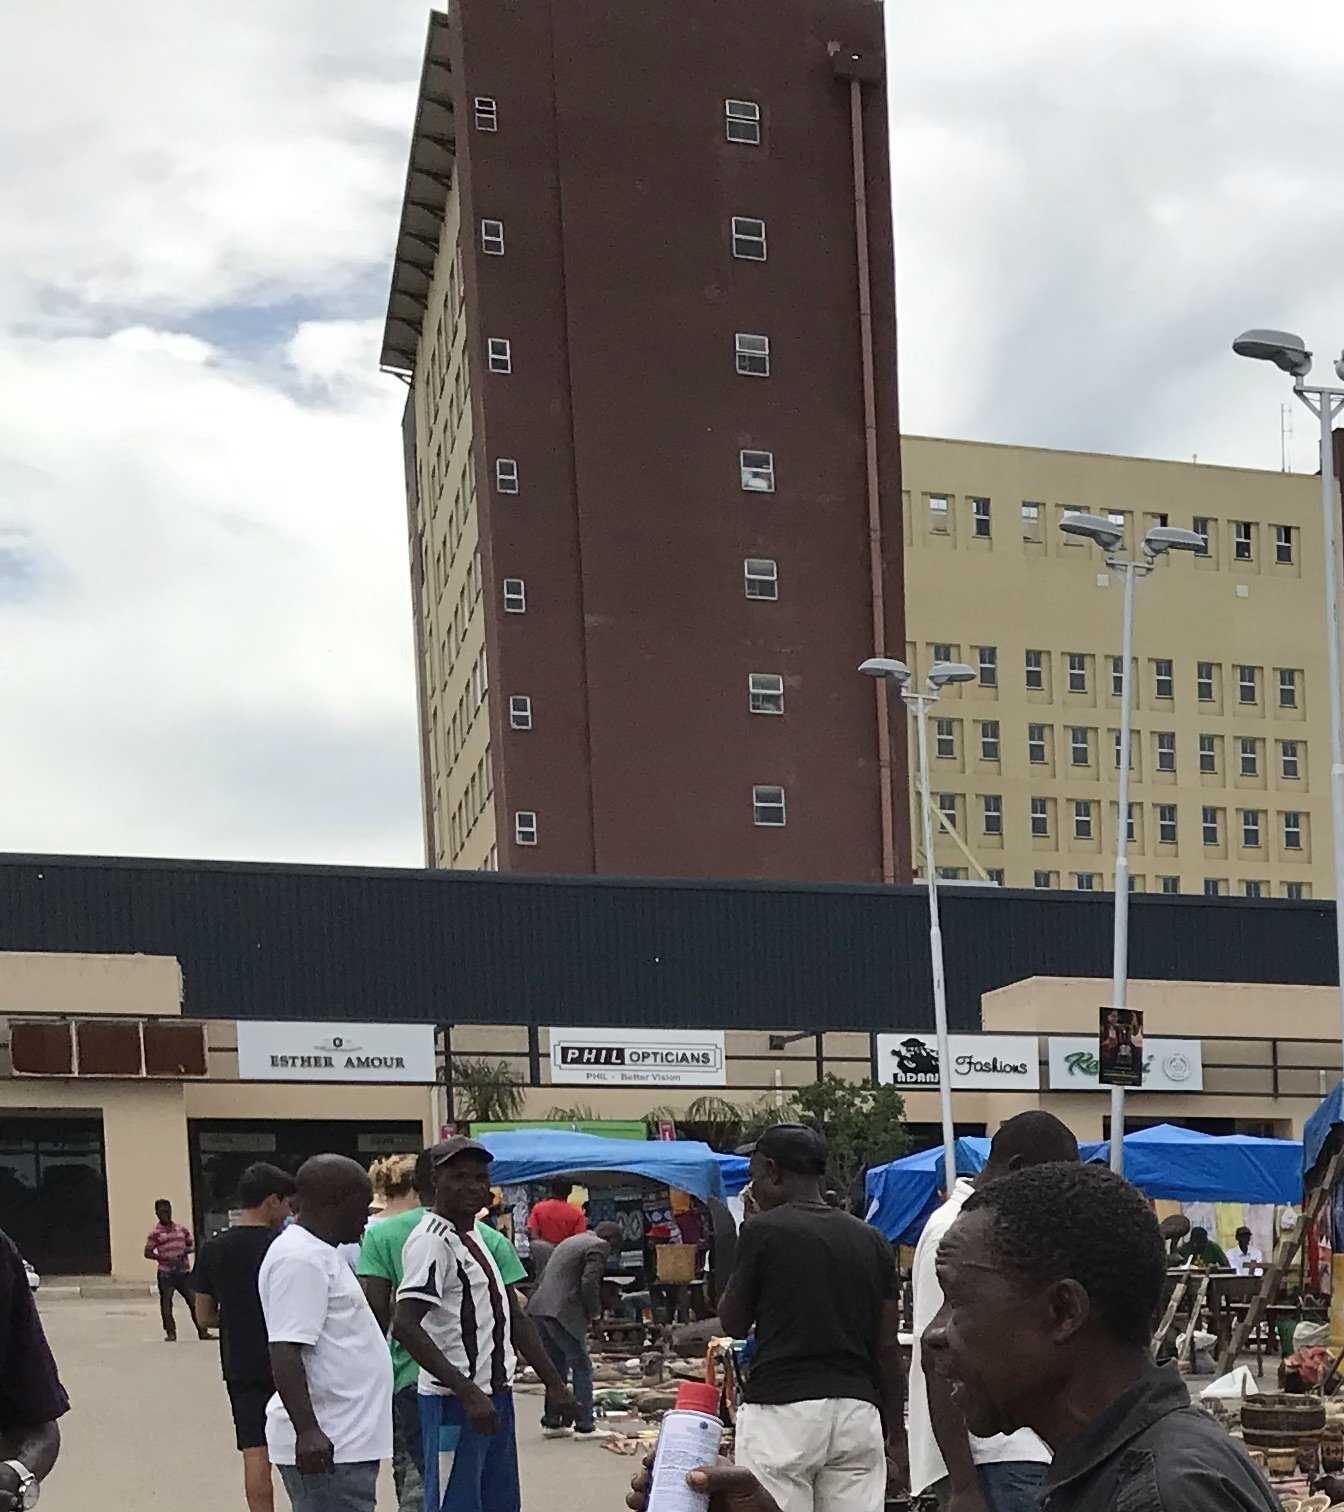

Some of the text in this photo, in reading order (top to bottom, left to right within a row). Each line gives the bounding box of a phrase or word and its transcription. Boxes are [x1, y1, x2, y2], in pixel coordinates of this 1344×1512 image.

[270, 1055, 406, 1069] ESTHER AMOUR
[566, 1048, 711, 1065] PHIL OPTICIANS
[955, 1054, 1028, 1076] Fashions
